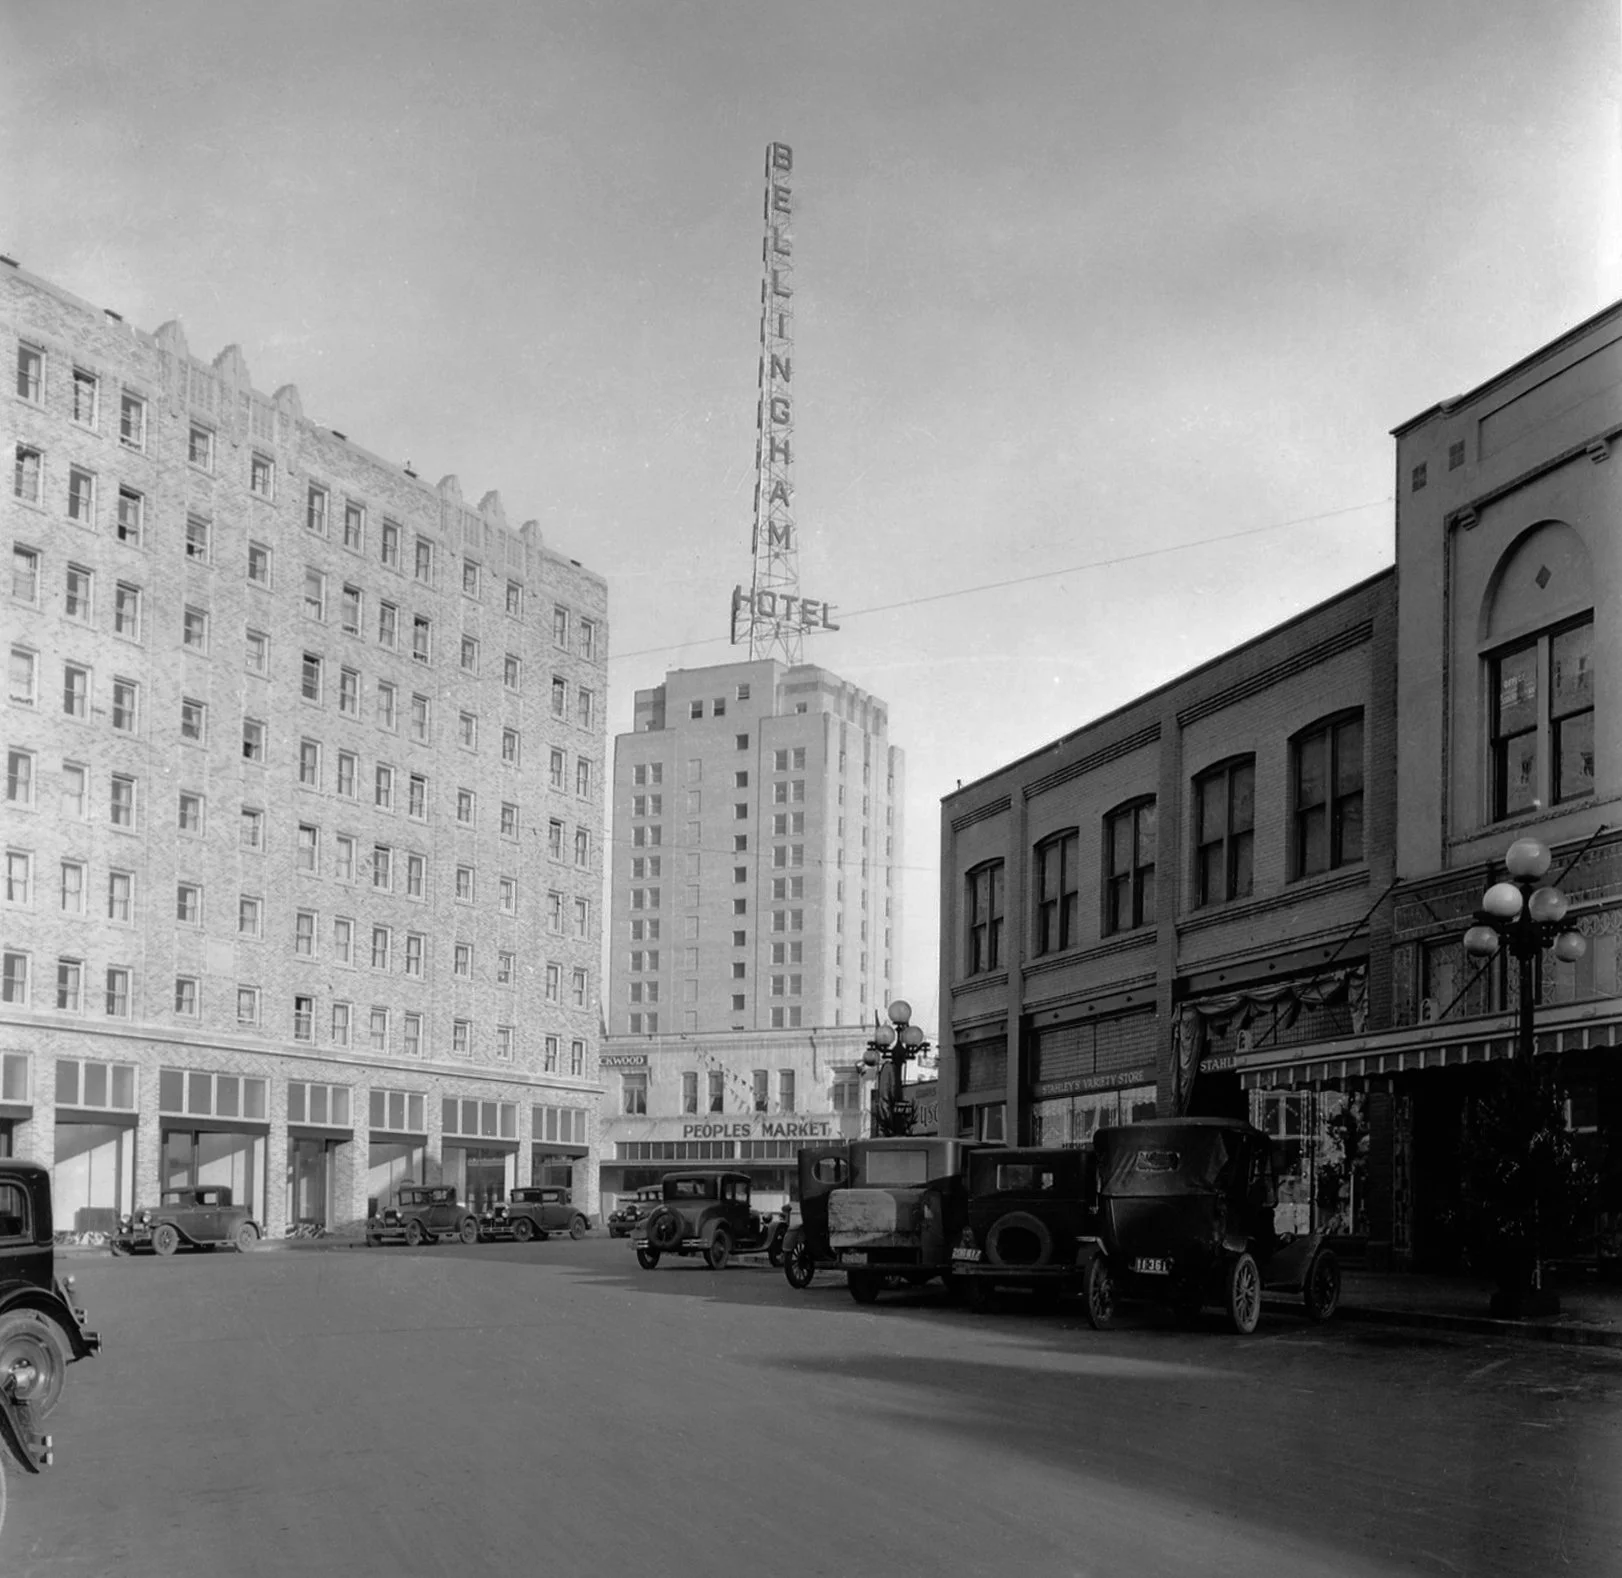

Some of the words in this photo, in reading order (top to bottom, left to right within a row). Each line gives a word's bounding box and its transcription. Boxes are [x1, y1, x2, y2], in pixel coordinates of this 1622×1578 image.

[769, 141, 793, 549] BELLINGHAM
[734, 585, 840, 632] HOTEL
[1082, 1074, 1117, 1089] VARIETY
[1118, 1070, 1145, 1085] STORE
[683, 1123, 751, 1139] PEOPLES
[762, 1122, 830, 1137] MARKET
